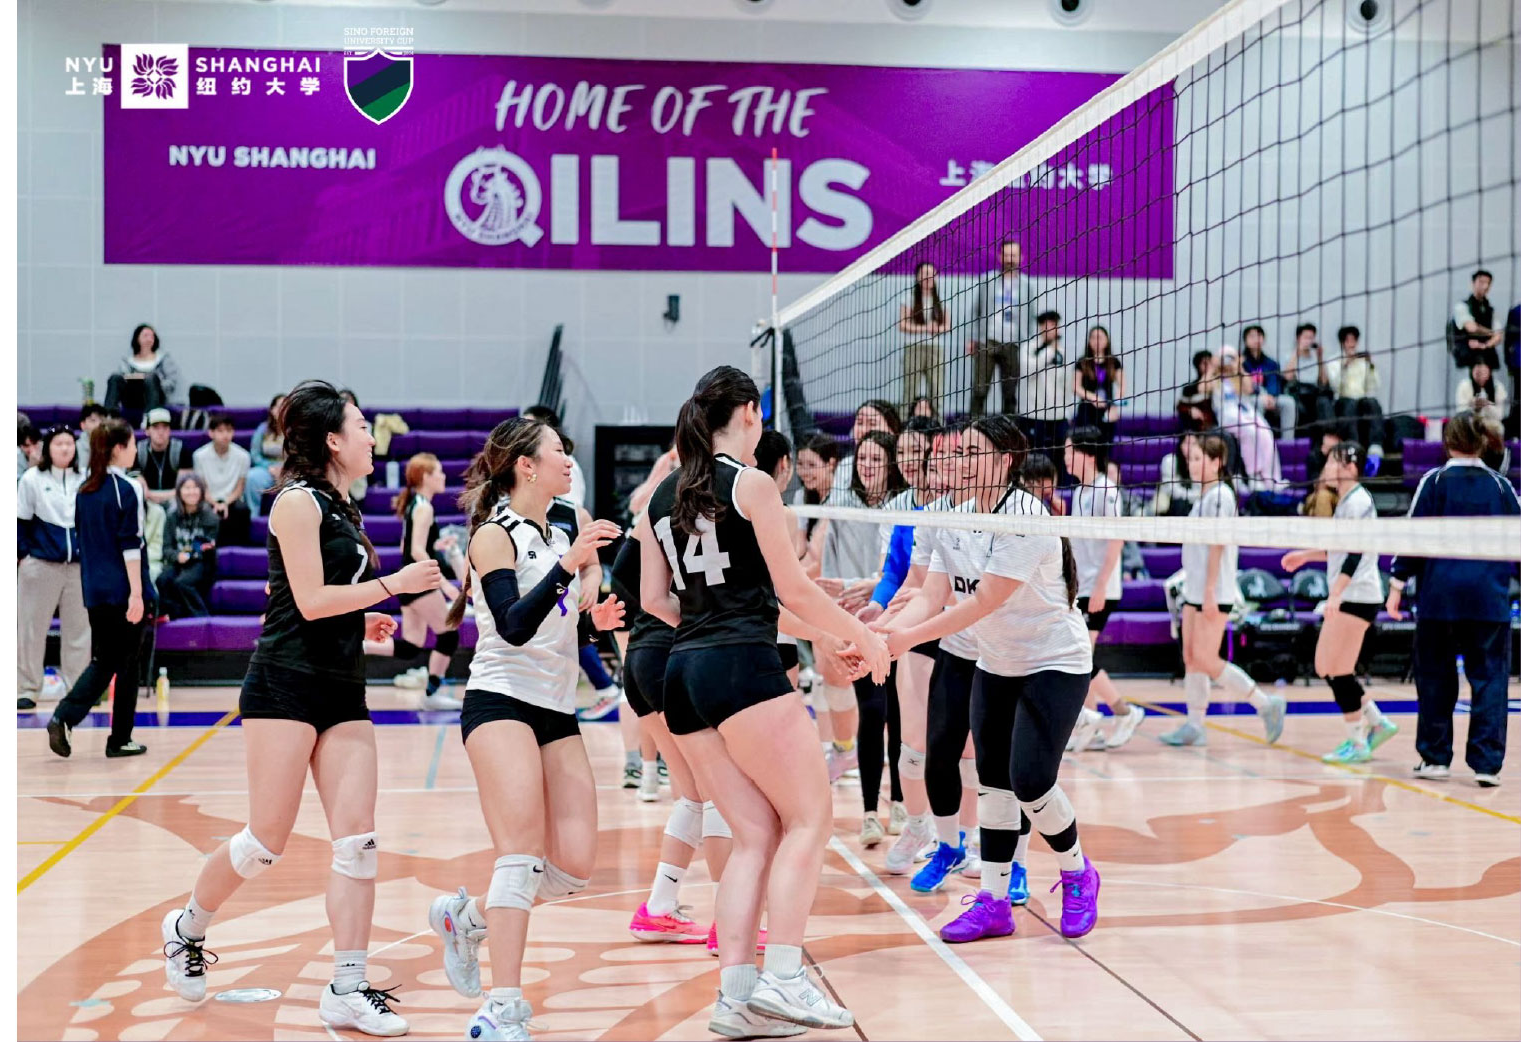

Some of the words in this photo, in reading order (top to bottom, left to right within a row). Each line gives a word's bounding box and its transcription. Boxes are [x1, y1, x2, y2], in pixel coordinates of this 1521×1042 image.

[495, 80, 646, 133] HOME
[651, 84, 728, 137] OF
[728, 86, 828, 138] THE
[168, 144, 227, 168] NYU
[233, 146, 377, 170] SHANGHAI
[444, 144, 873, 251] QILINS
[653, 507, 732, 591] 14
